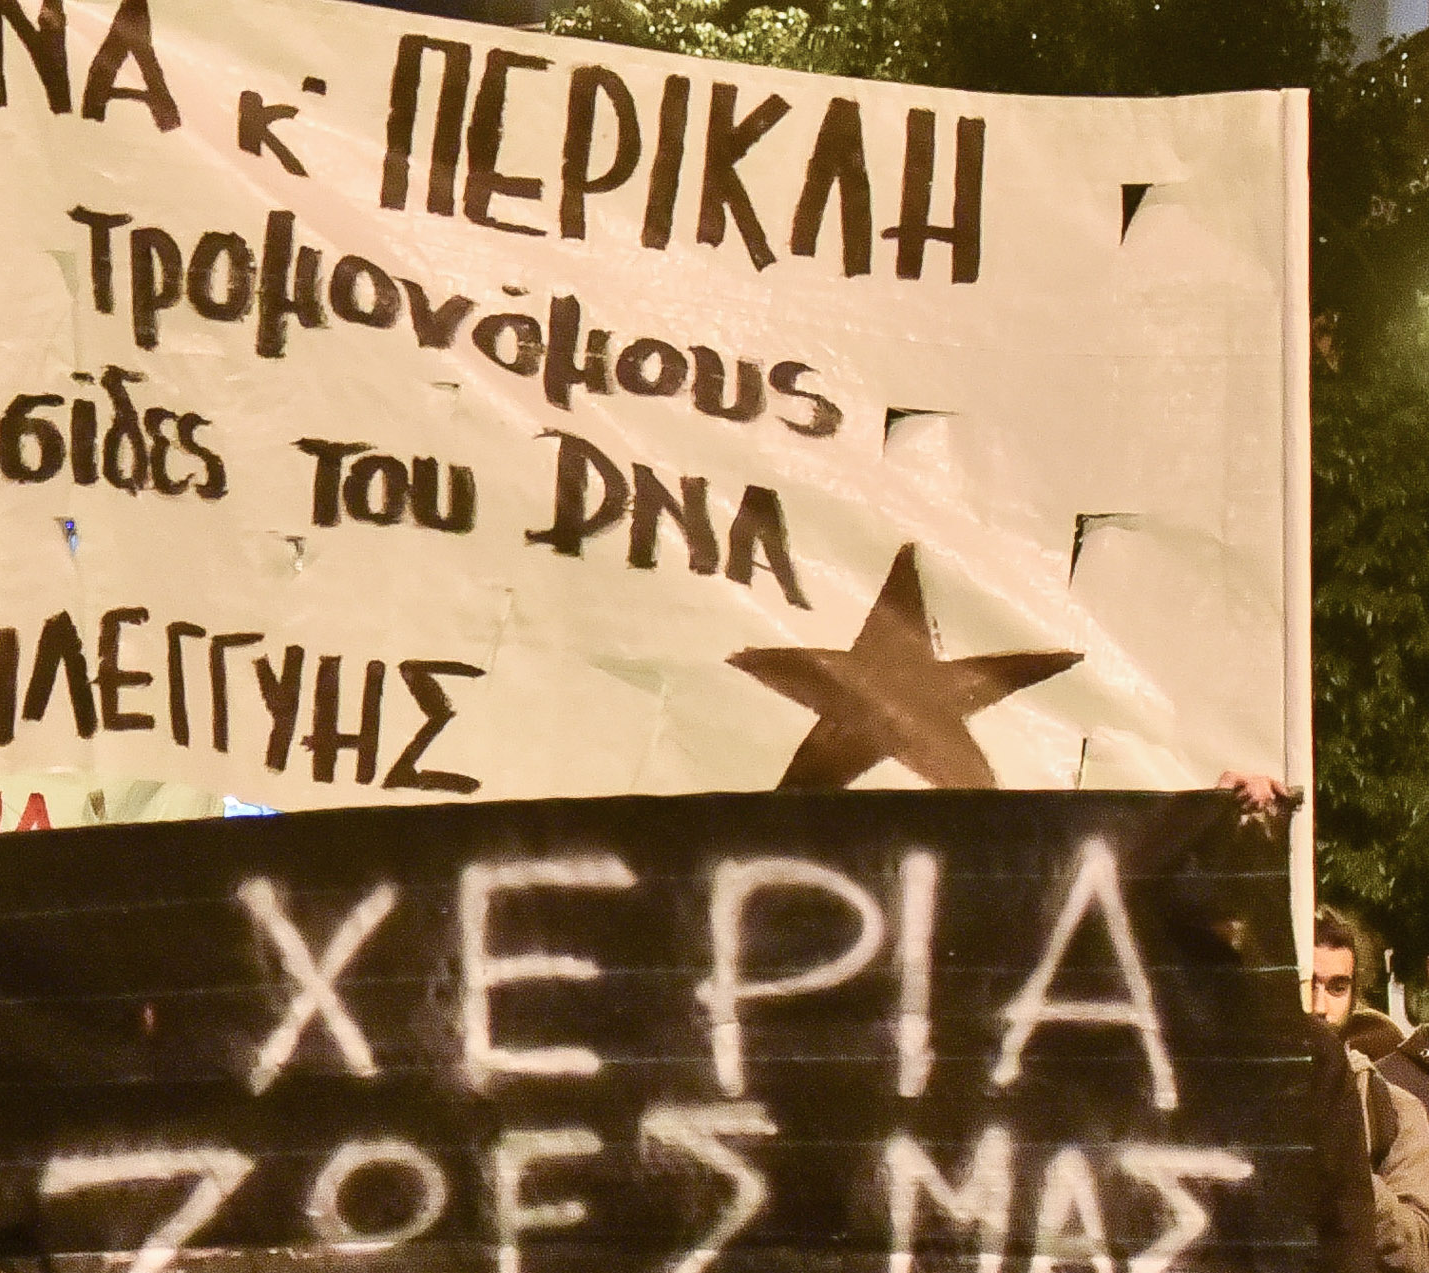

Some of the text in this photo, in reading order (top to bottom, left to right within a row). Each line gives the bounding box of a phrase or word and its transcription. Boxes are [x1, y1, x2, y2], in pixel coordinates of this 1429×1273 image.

[379, 33, 988, 285] ΠΕΡΙΚΛΗ
[294, 437, 477, 533] του
[233, 833, 1181, 1112] ΧΕΡΙΑ
